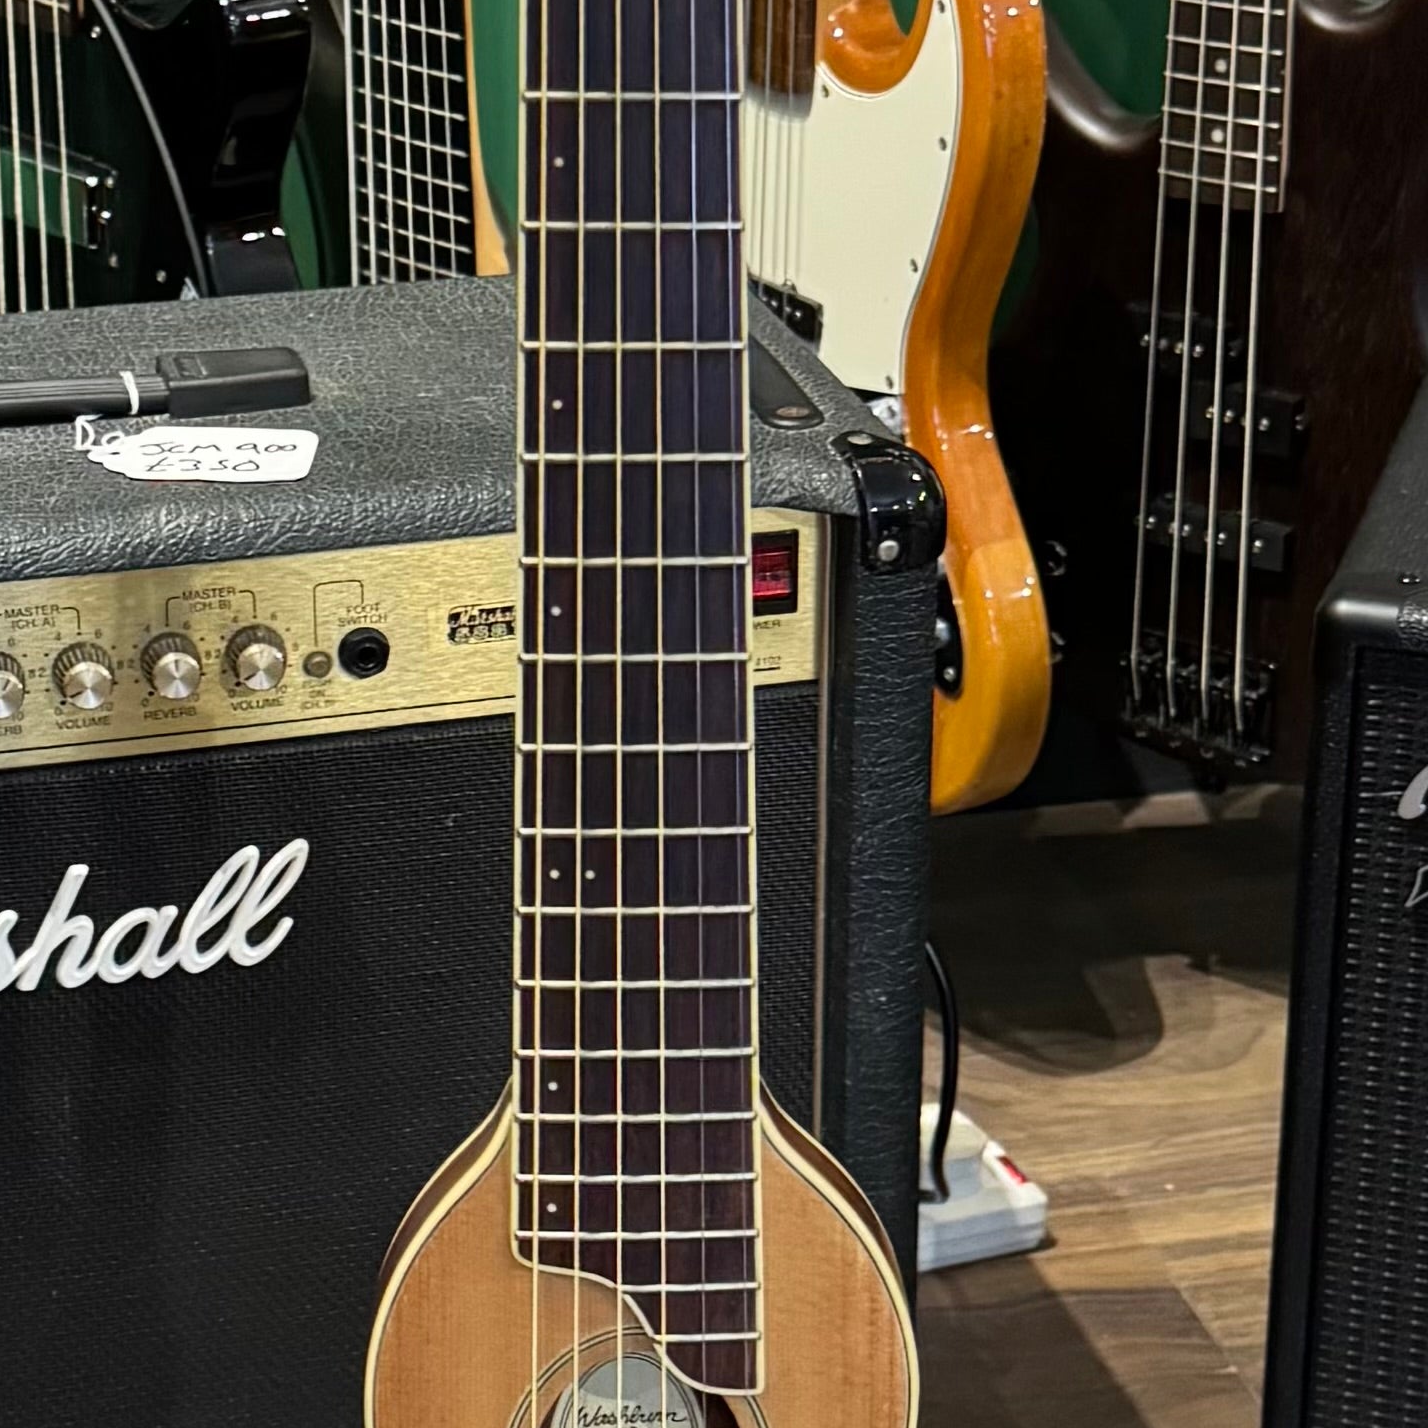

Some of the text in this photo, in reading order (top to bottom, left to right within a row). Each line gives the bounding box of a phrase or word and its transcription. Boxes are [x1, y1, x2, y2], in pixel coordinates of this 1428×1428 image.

[182, 587, 236, 600] MASTER
[4, 604, 61, 618] MASTER
[231, 697, 285, 712] VOLUME
[143, 706, 197, 720] REVERB
[56, 715, 112, 730] VOLUME
